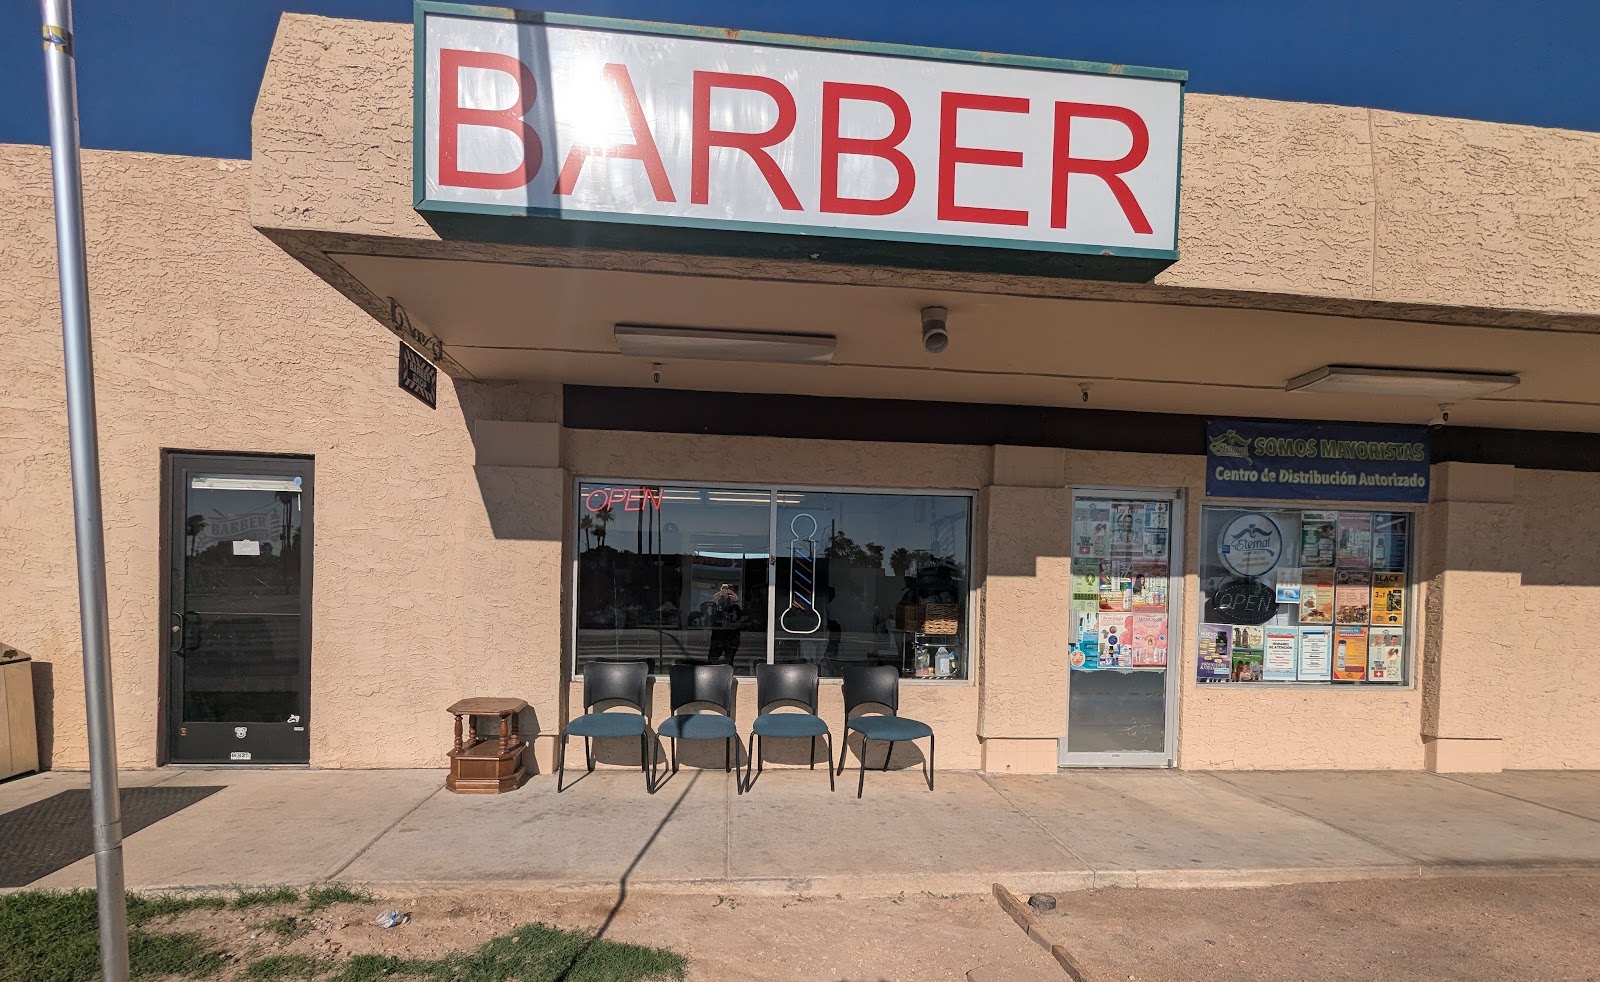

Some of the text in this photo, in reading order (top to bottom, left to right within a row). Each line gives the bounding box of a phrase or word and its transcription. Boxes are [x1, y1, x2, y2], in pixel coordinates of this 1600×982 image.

[438, 48, 1154, 236] BARBER
[1254, 437, 1425, 462] SOMOS MAYORISTAS
[1215, 465, 1426, 488] Centro de Distribución Autorizado
[586, 488, 664, 512] OPEN
[211, 516, 266, 536] BARBER
[1375, 574, 1399, 582] BLACK
[1219, 593, 1273, 613] OPEN
